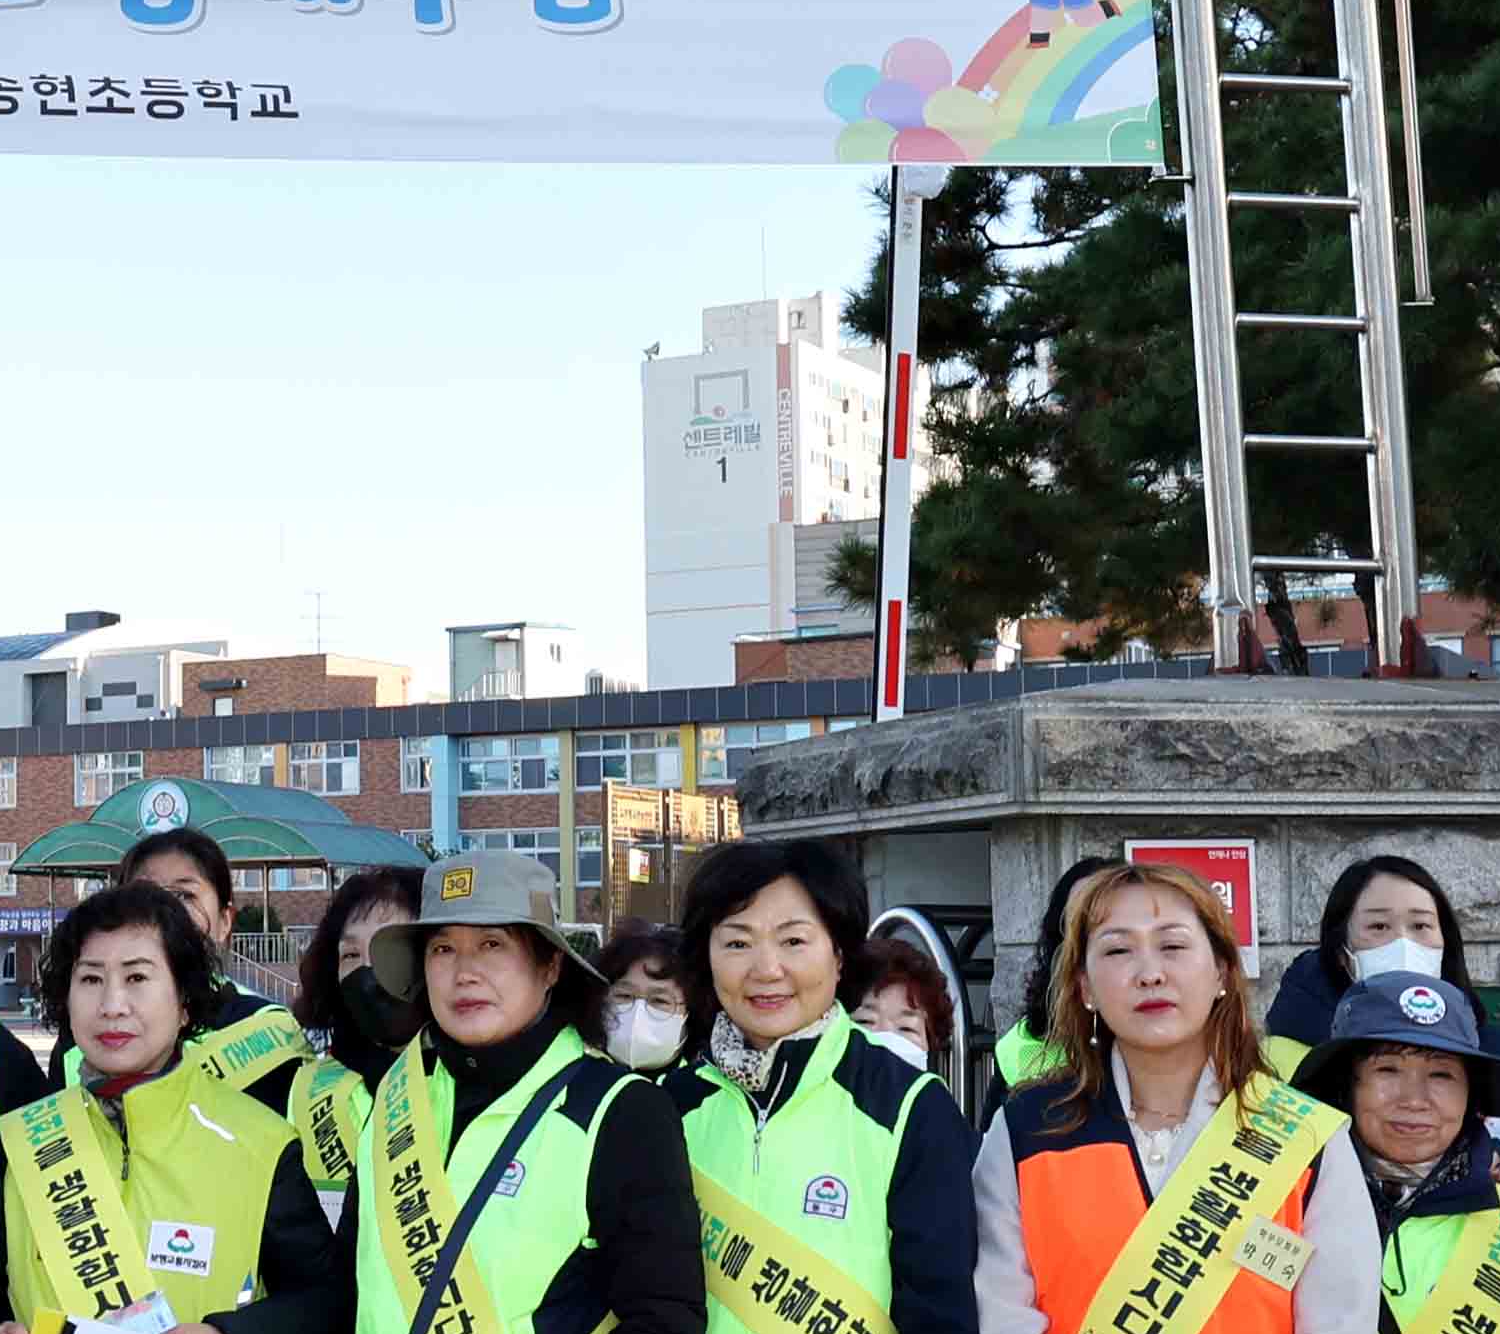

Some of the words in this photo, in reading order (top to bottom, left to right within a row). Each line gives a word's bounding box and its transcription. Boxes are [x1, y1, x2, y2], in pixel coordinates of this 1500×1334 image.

[683, 422, 760, 449] 센트레빌
[716, 456, 727, 483] 1
[45, 1168, 135, 1320] 생활화합시
